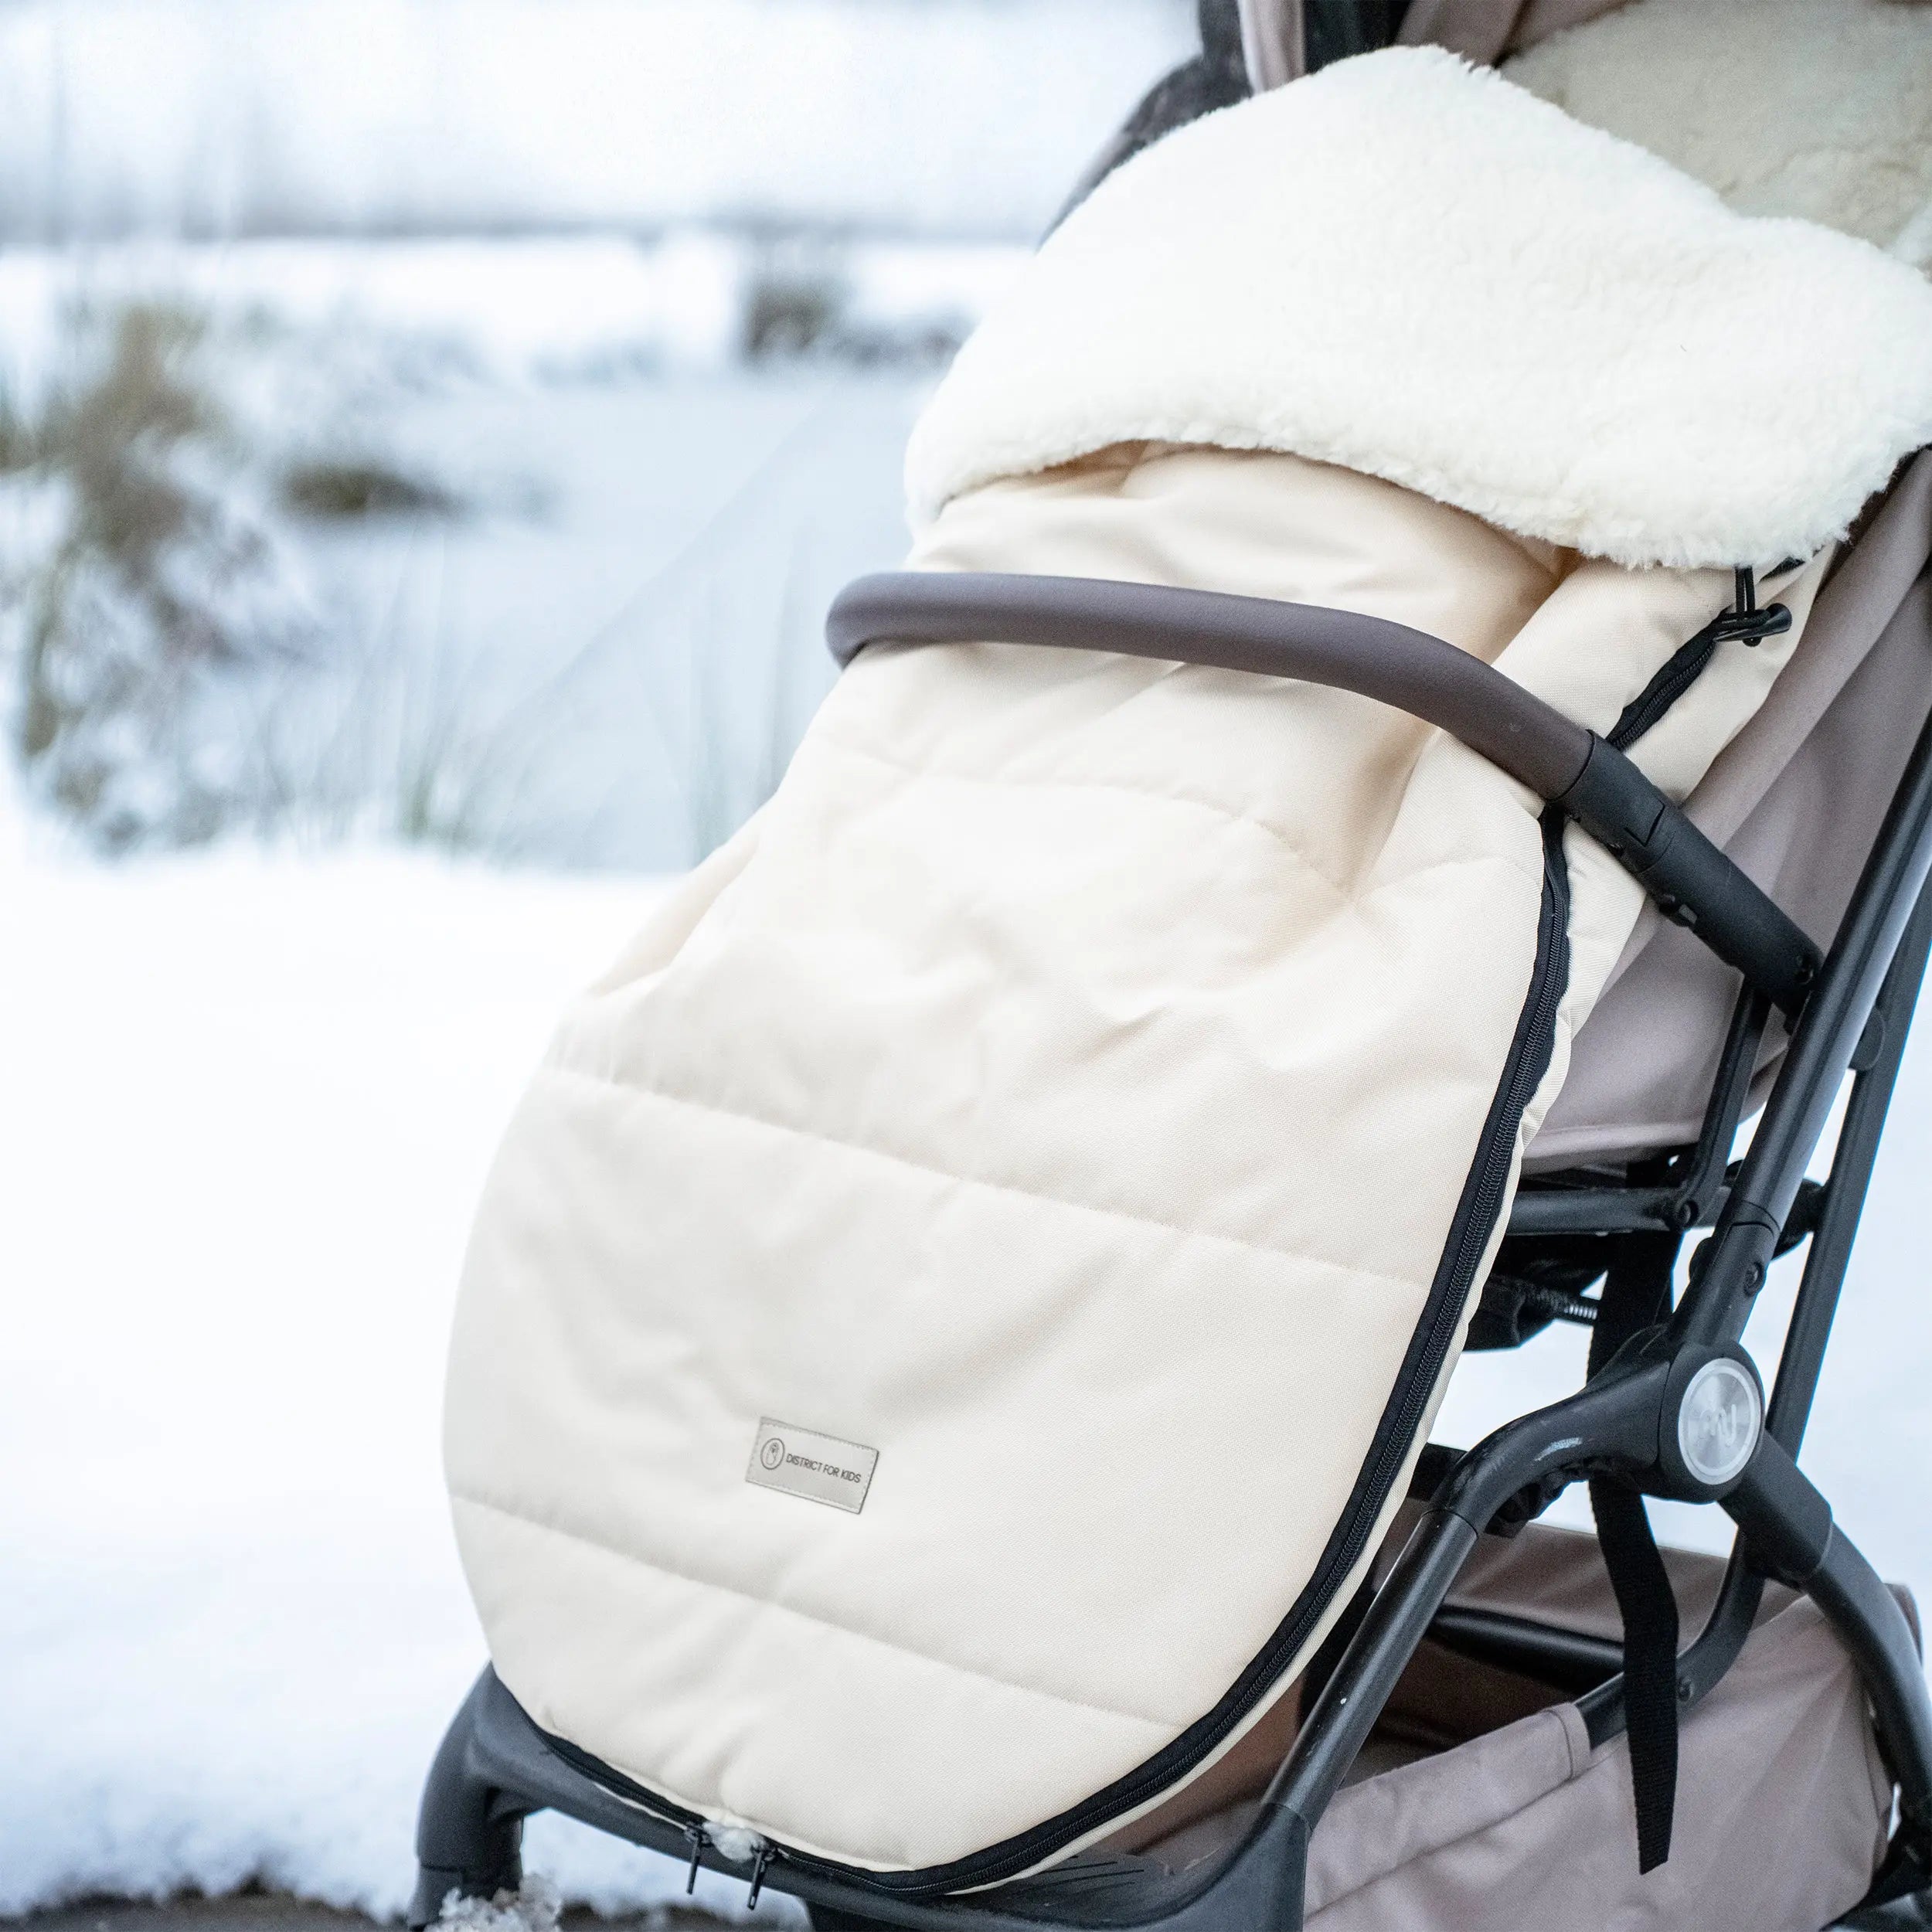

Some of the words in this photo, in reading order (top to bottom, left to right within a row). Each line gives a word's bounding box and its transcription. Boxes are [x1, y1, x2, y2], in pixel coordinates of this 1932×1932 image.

[786, 1453, 822, 1472] DISTRICT
[822, 1464, 840, 1478] FOR
[840, 1470, 862, 1484] KIDS
